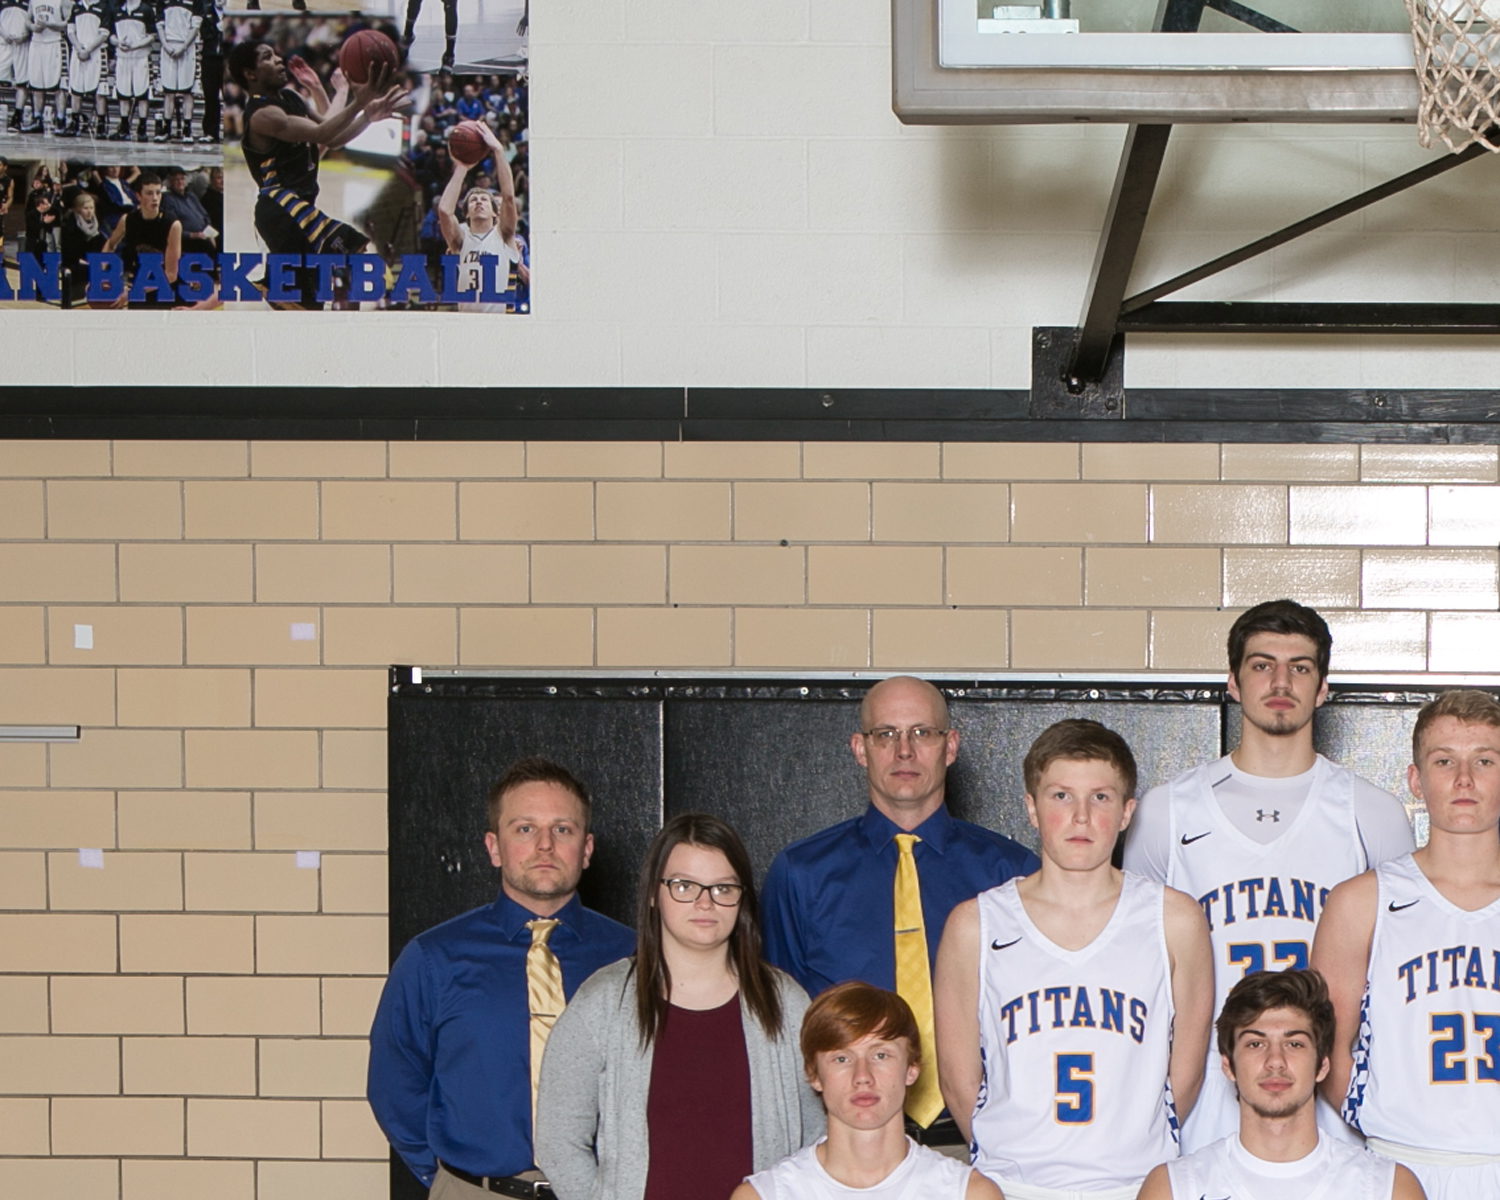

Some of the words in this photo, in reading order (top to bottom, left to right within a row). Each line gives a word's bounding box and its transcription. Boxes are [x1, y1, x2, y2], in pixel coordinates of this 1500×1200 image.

[0, 252, 61, 301] N
[86, 252, 516, 304] BASKETBALL
[1000, 985, 1148, 1045] TITANS
[1053, 1051, 1096, 1127] 5
